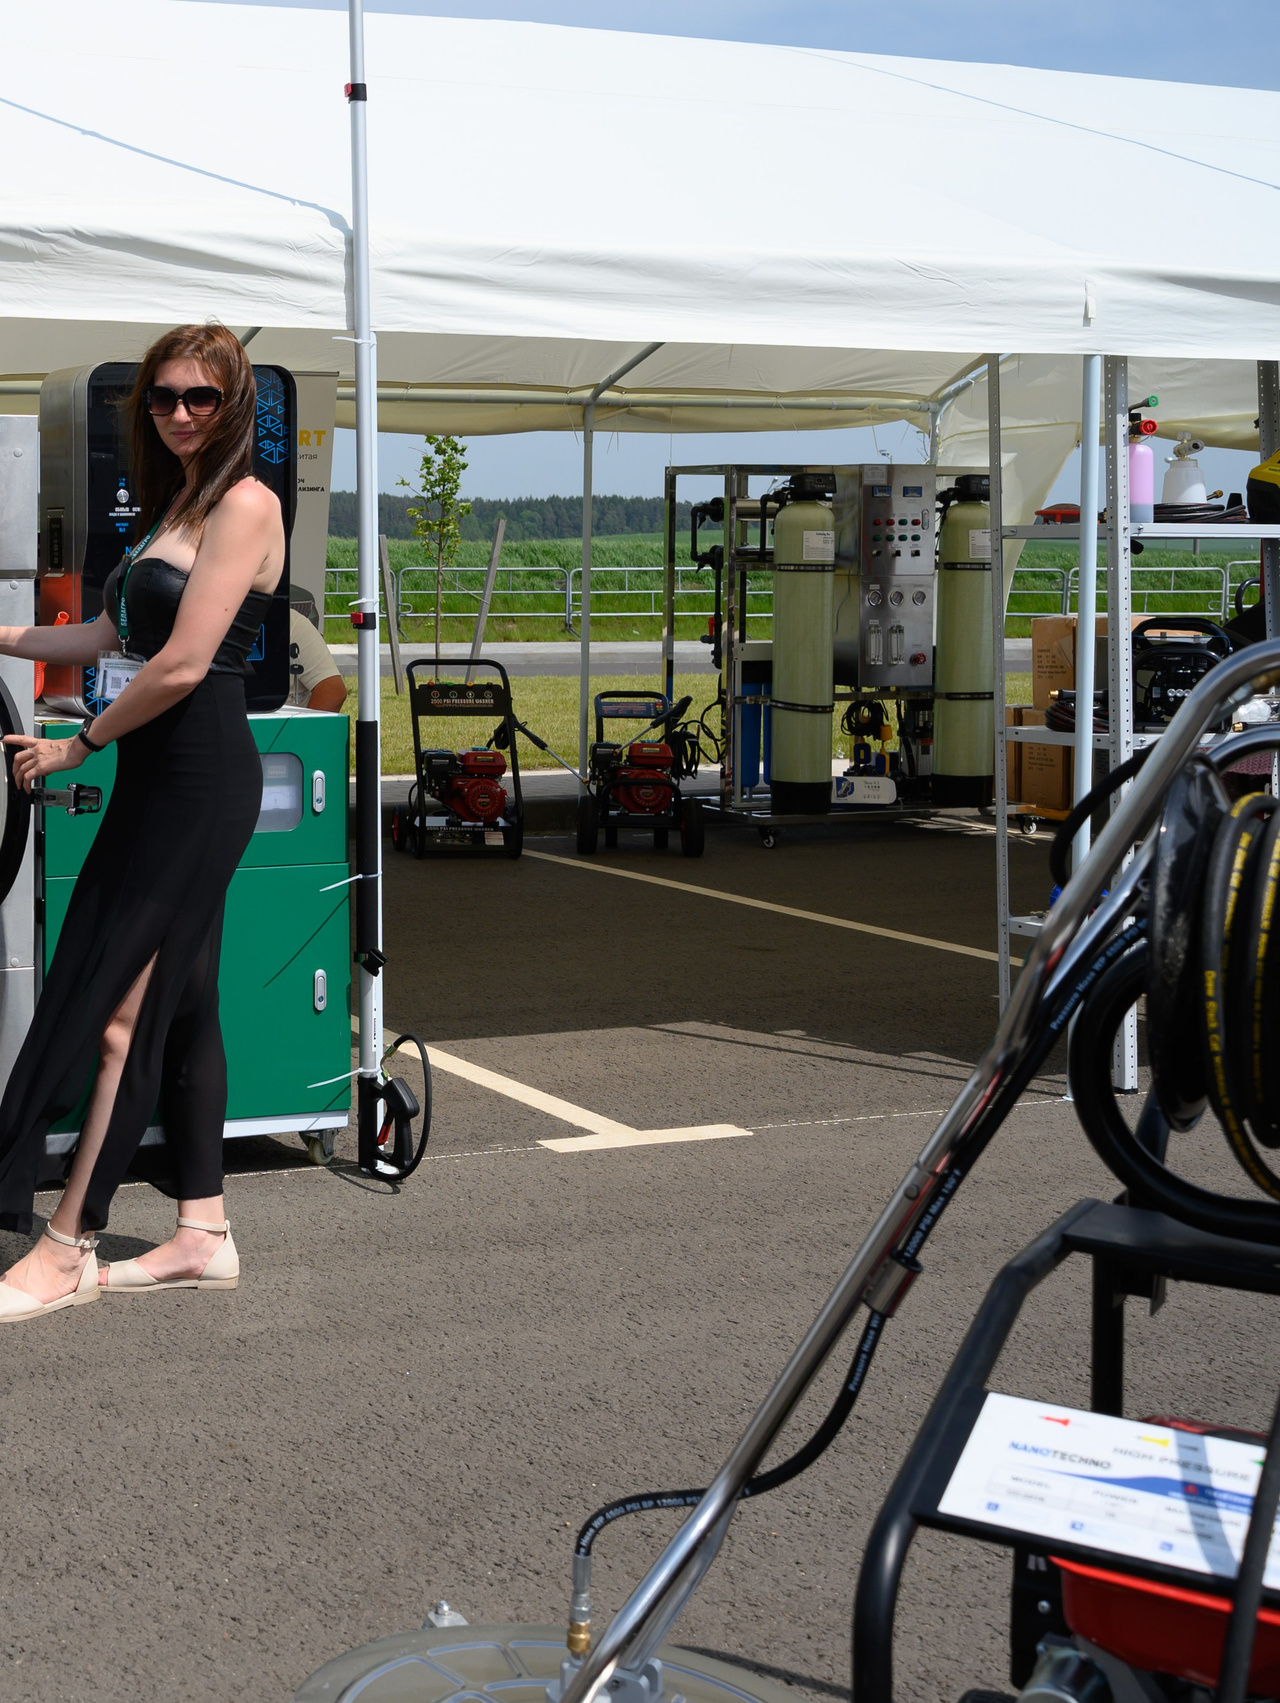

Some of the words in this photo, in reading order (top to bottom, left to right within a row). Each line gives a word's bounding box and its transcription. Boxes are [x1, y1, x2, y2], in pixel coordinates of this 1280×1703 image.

[298, 429, 326, 447] RT
[120, 597, 128, 627] БЕЛАГРО
[580, 1527, 596, 1547] Hose
